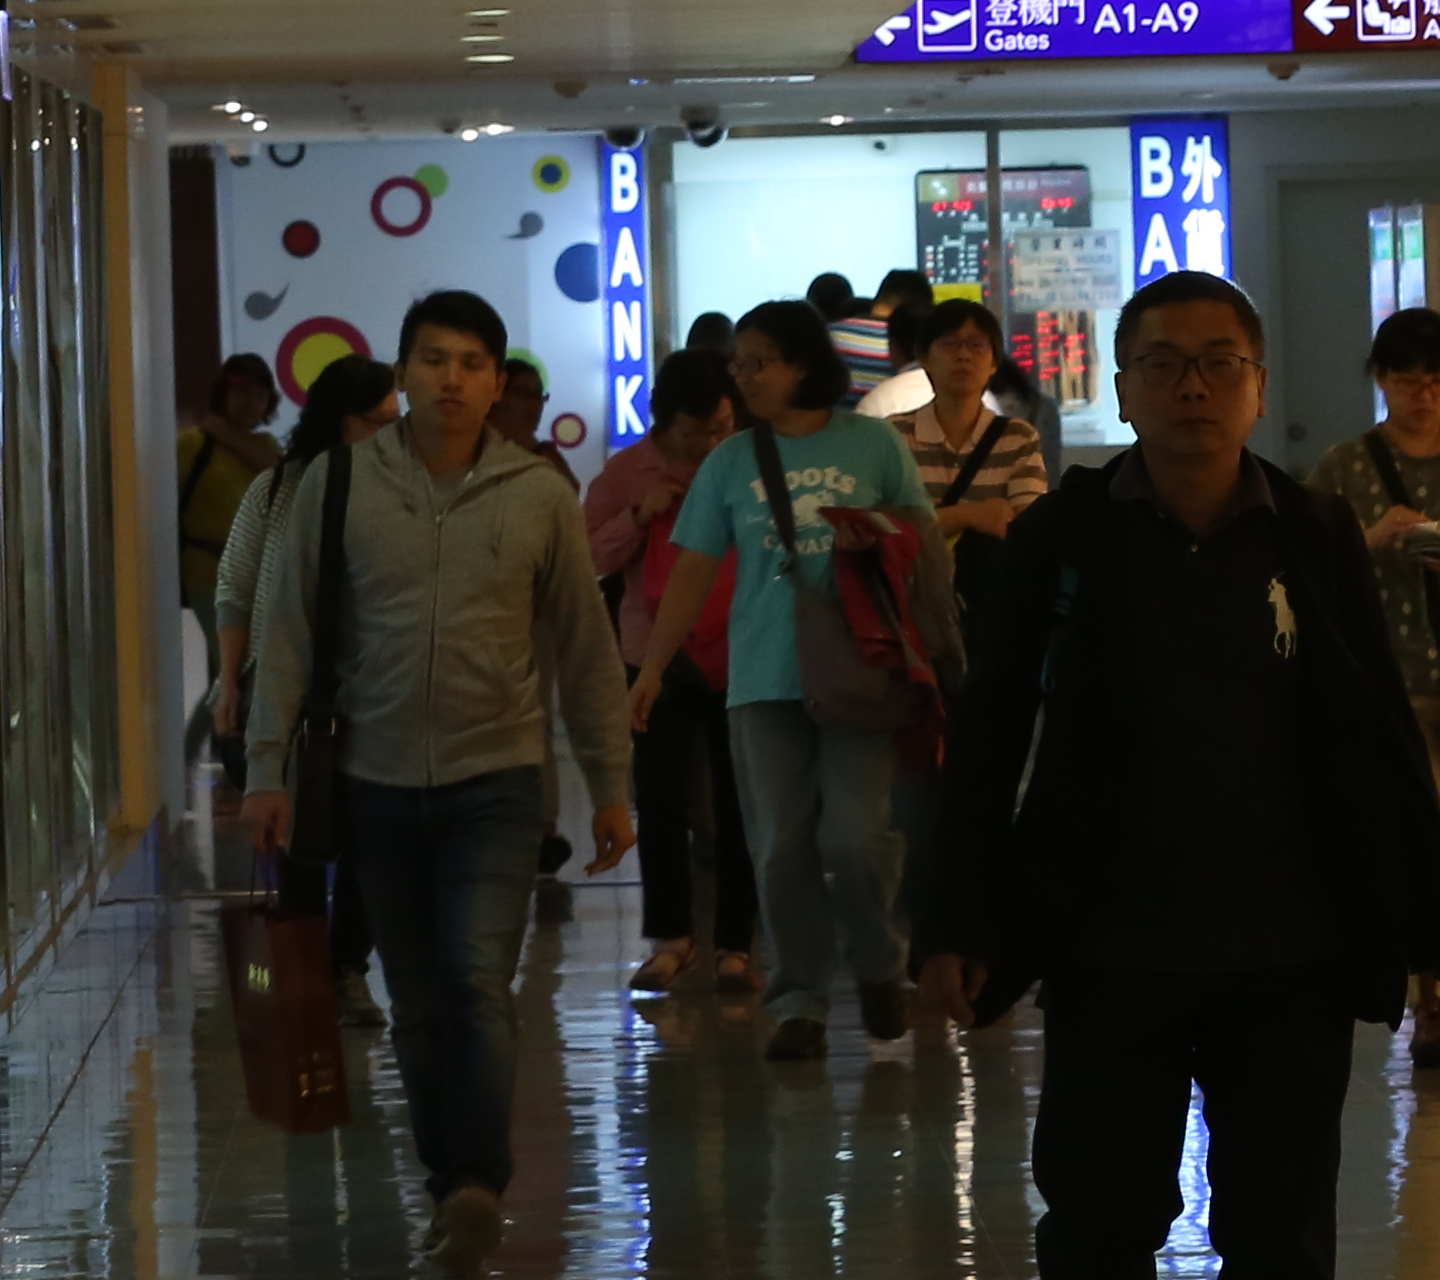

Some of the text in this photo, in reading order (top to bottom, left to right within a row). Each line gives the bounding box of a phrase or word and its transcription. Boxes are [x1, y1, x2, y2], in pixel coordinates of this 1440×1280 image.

[1093, 1, 1199, 34] A1-A9
[984, 28, 1050, 53] Gates
[609, 151, 647, 436] BANK
